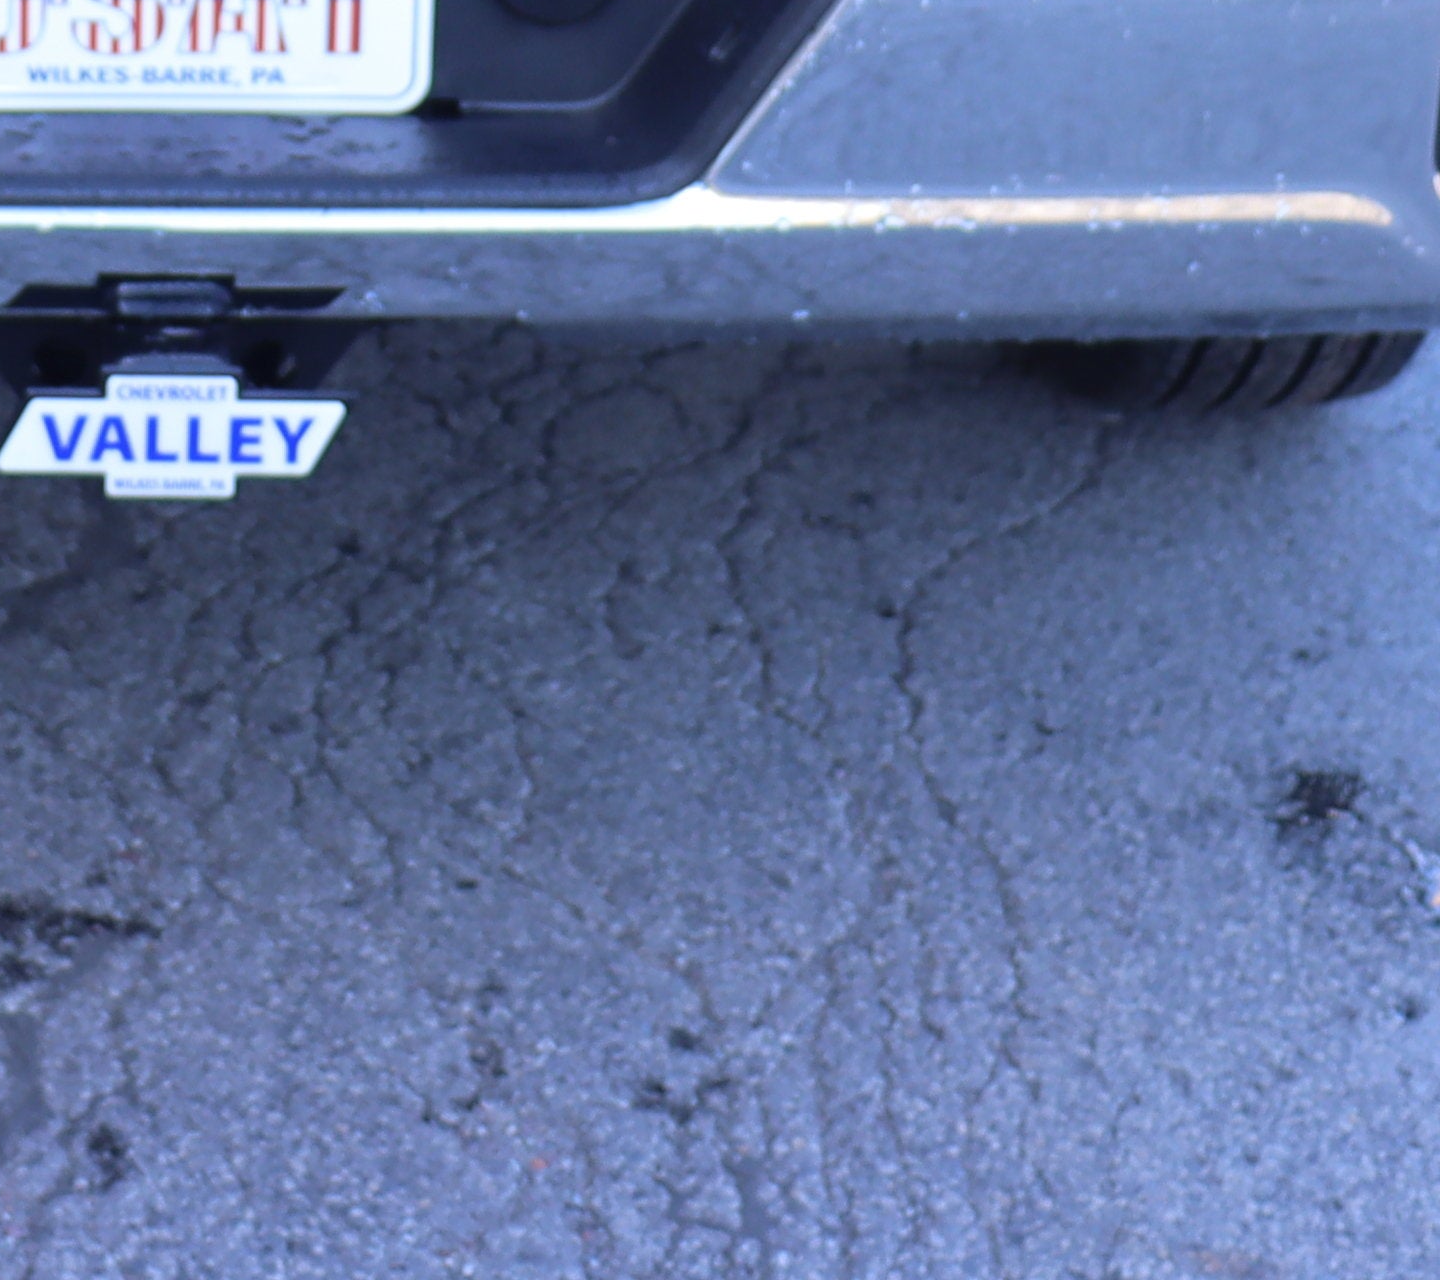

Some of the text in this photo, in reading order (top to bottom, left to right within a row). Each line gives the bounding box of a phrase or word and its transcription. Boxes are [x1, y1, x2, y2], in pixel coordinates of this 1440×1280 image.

[27, 64, 286, 87] WILKES-BARRE, PA
[41, 413, 316, 465] VALLEY
